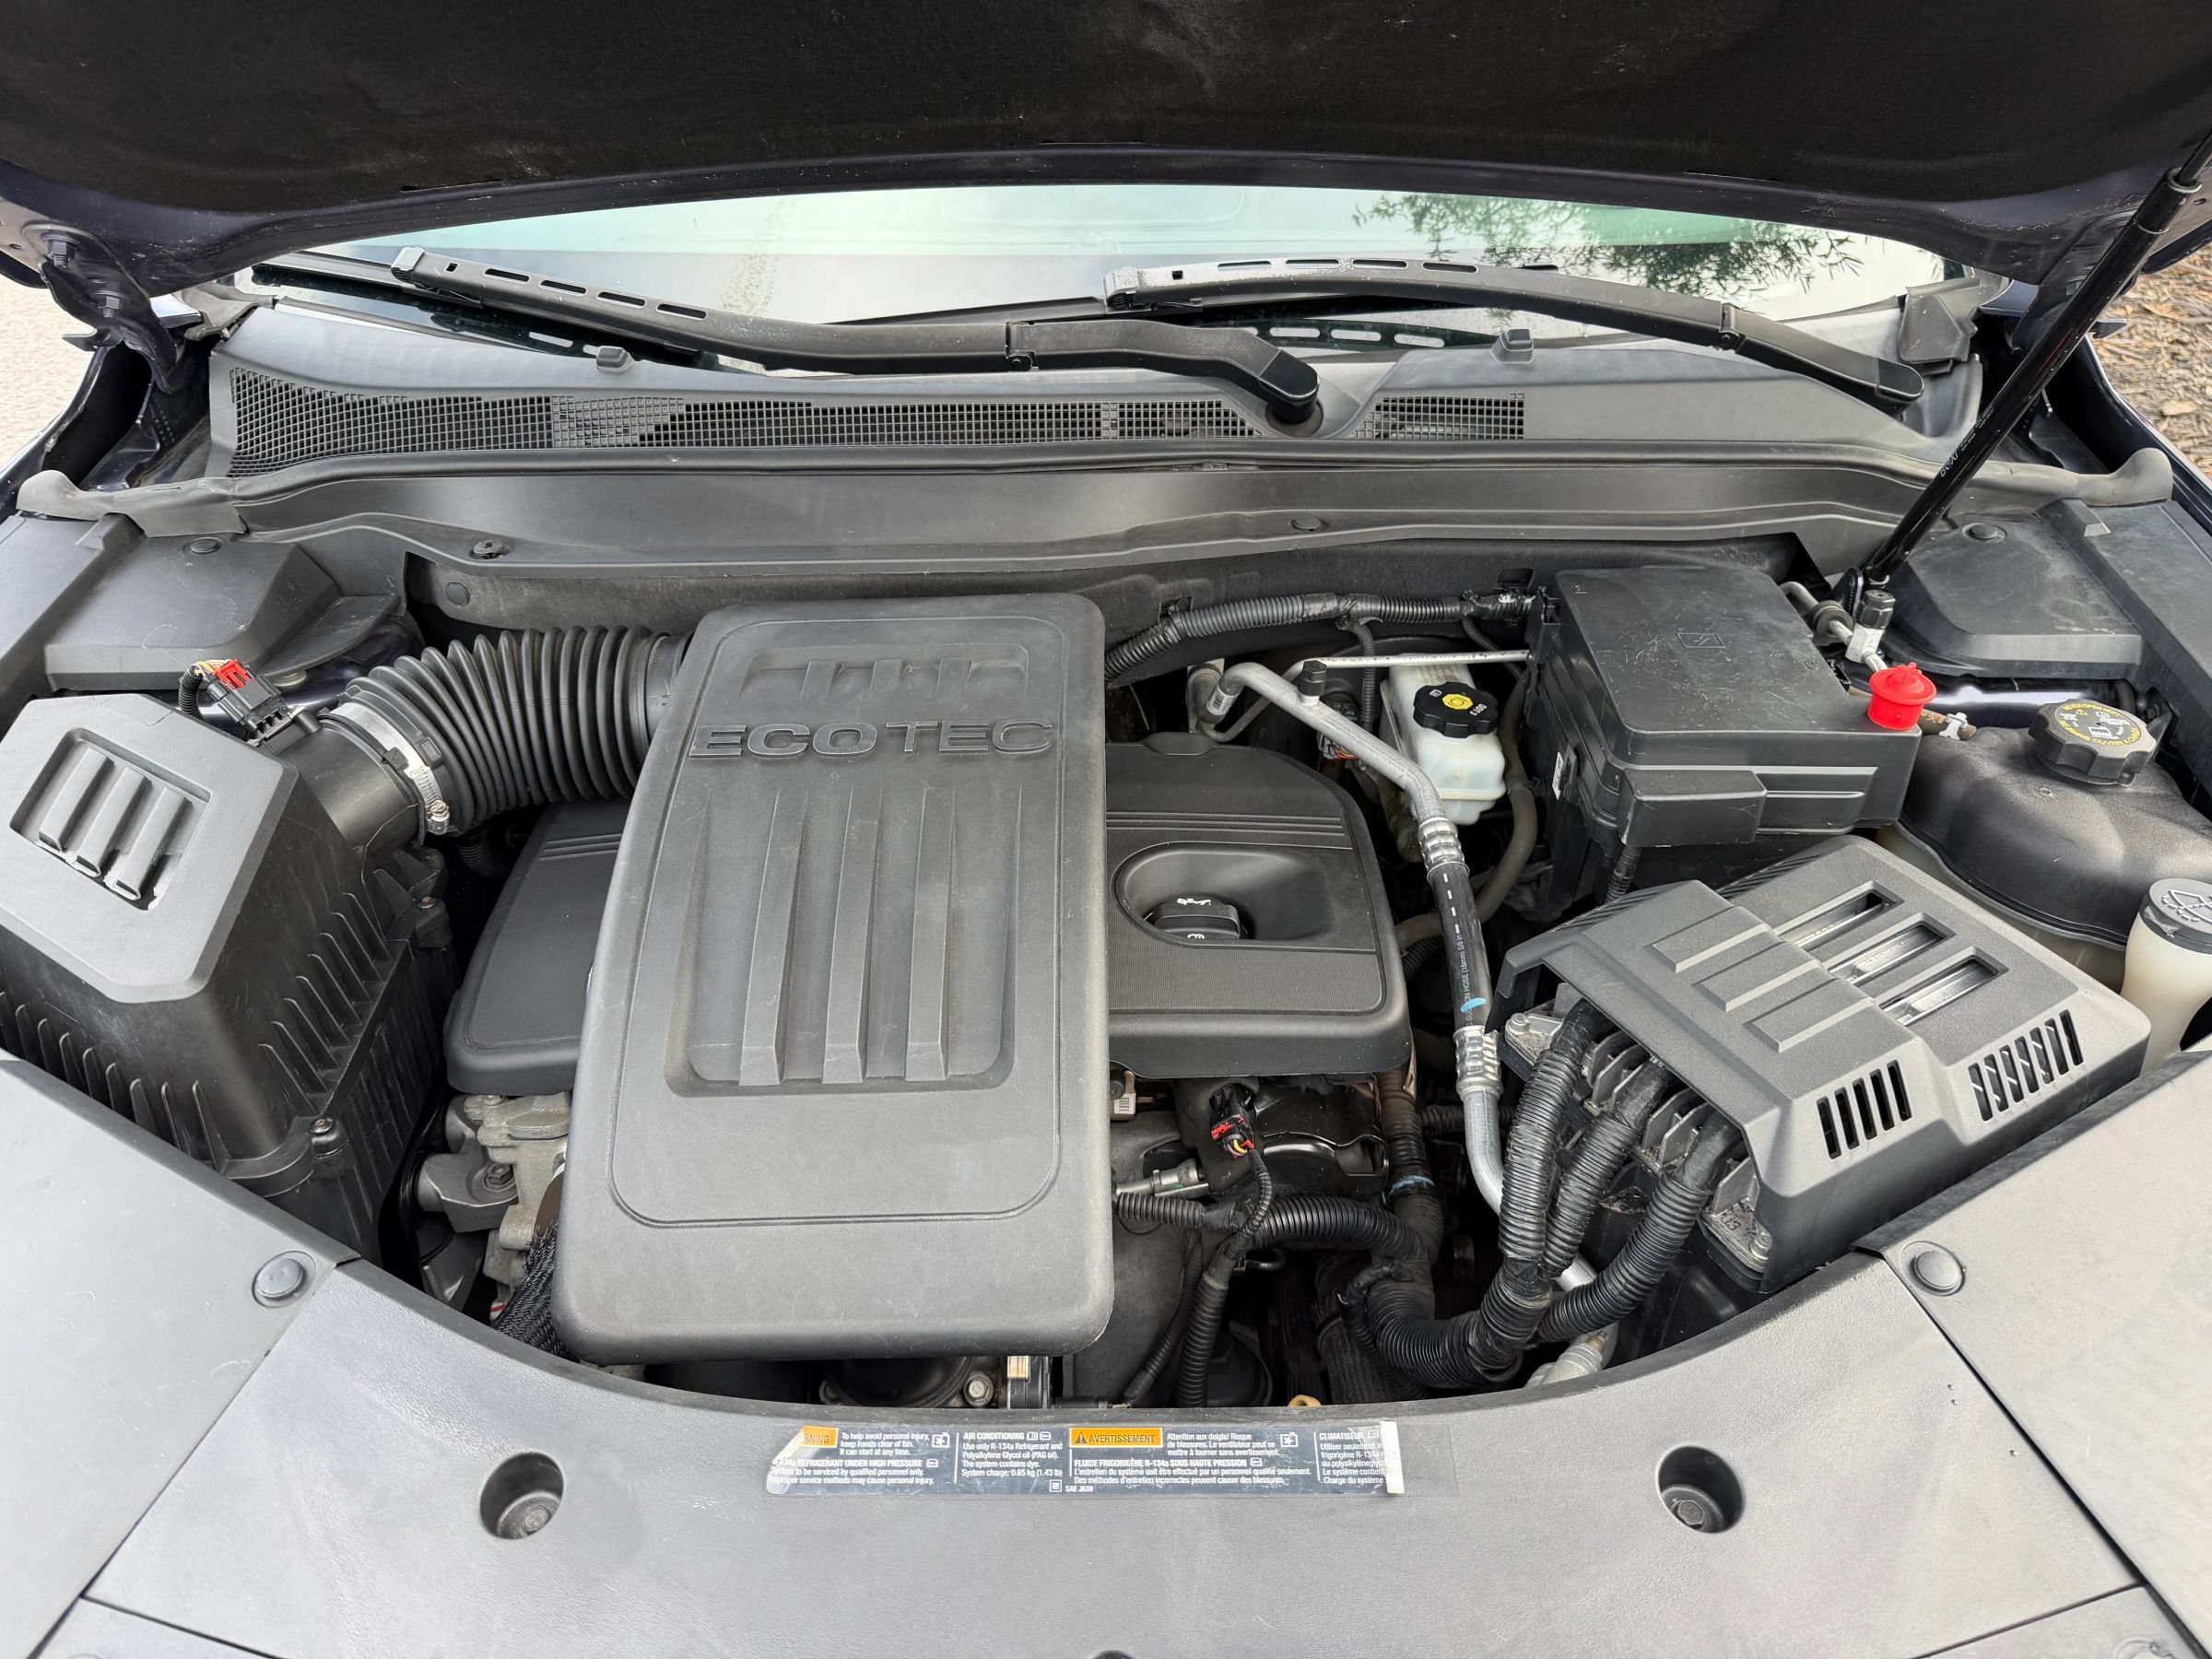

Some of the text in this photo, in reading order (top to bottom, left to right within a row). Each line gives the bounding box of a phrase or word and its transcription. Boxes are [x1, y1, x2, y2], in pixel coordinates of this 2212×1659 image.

[688, 718, 1053, 759] ECOTEC
[1462, 972, 1470, 993] HOSE
[804, 1434, 830, 1443] RNING
[977, 1431, 1025, 1440] CONDITIONING
[1088, 1434, 1155, 1443] AVERTISSEMENT
[977, 1442, 989, 1451] only
[991, 1442, 1014, 1451] R-134a
[1015, 1442, 1050, 1451] Refrigerant
[1050, 1442, 1063, 1451] and
[1002, 1452, 1021, 1460] Glycol
[1031, 1452, 1046, 1460] (PAG
[797, 1459, 844, 1467] REFRIGERANT
[844, 1459, 868, 1467] UNDER
[869, 1459, 886, 1467] HIGH
[887, 1459, 923, 1467] PRESSURE
[975, 1460, 998, 1468] system
[999, 1460, 1026, 1468] contains
[812, 1467, 840, 1476] serviced
[850, 1467, 877, 1476] qualified
[877, 1467, 909, 1476] personnel
[961, 1469, 985, 1477] System
[1221, 1467, 1252, 1476] personnel
[1324, 1477, 1347, 1485] Charge
